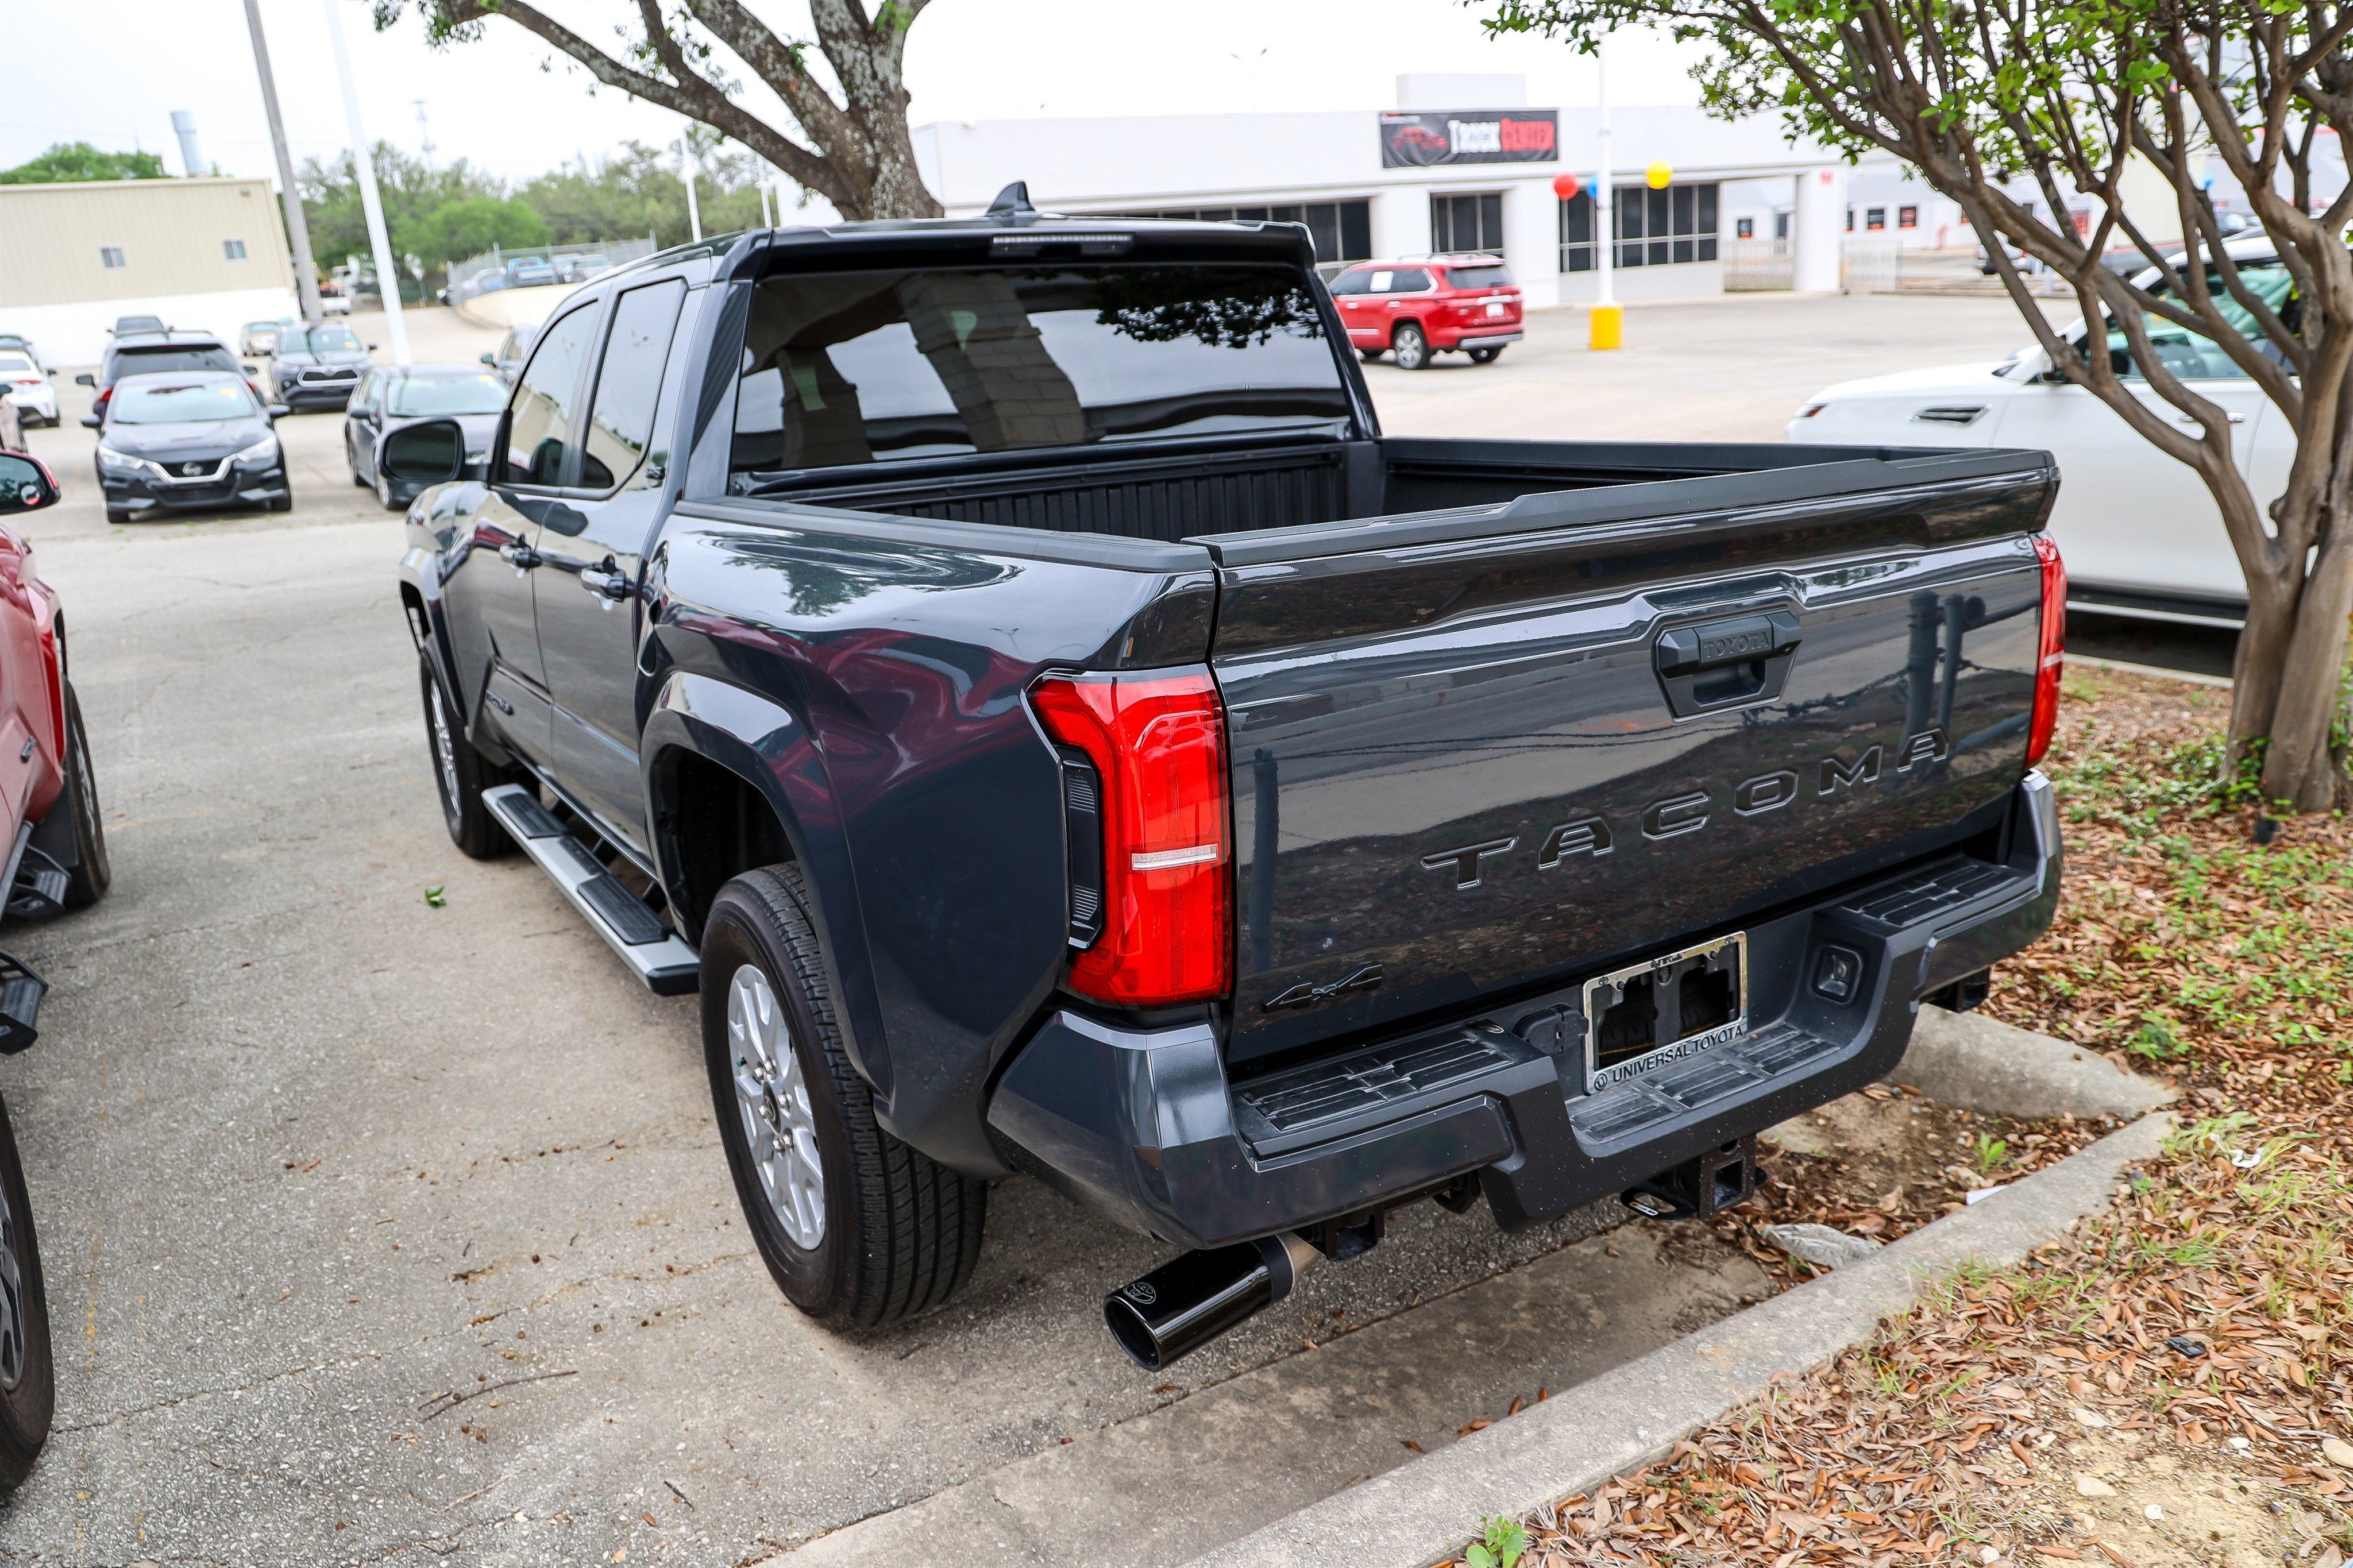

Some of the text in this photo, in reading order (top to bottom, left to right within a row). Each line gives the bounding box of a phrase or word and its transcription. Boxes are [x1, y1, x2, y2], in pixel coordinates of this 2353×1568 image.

[1703, 631, 1770, 658] TOYOTA
[1420, 725, 1950, 890] TACOMA
[1612, 1043, 1692, 1083] UNIVERSAL
[1692, 1024, 1745, 1053] TOYOTA
